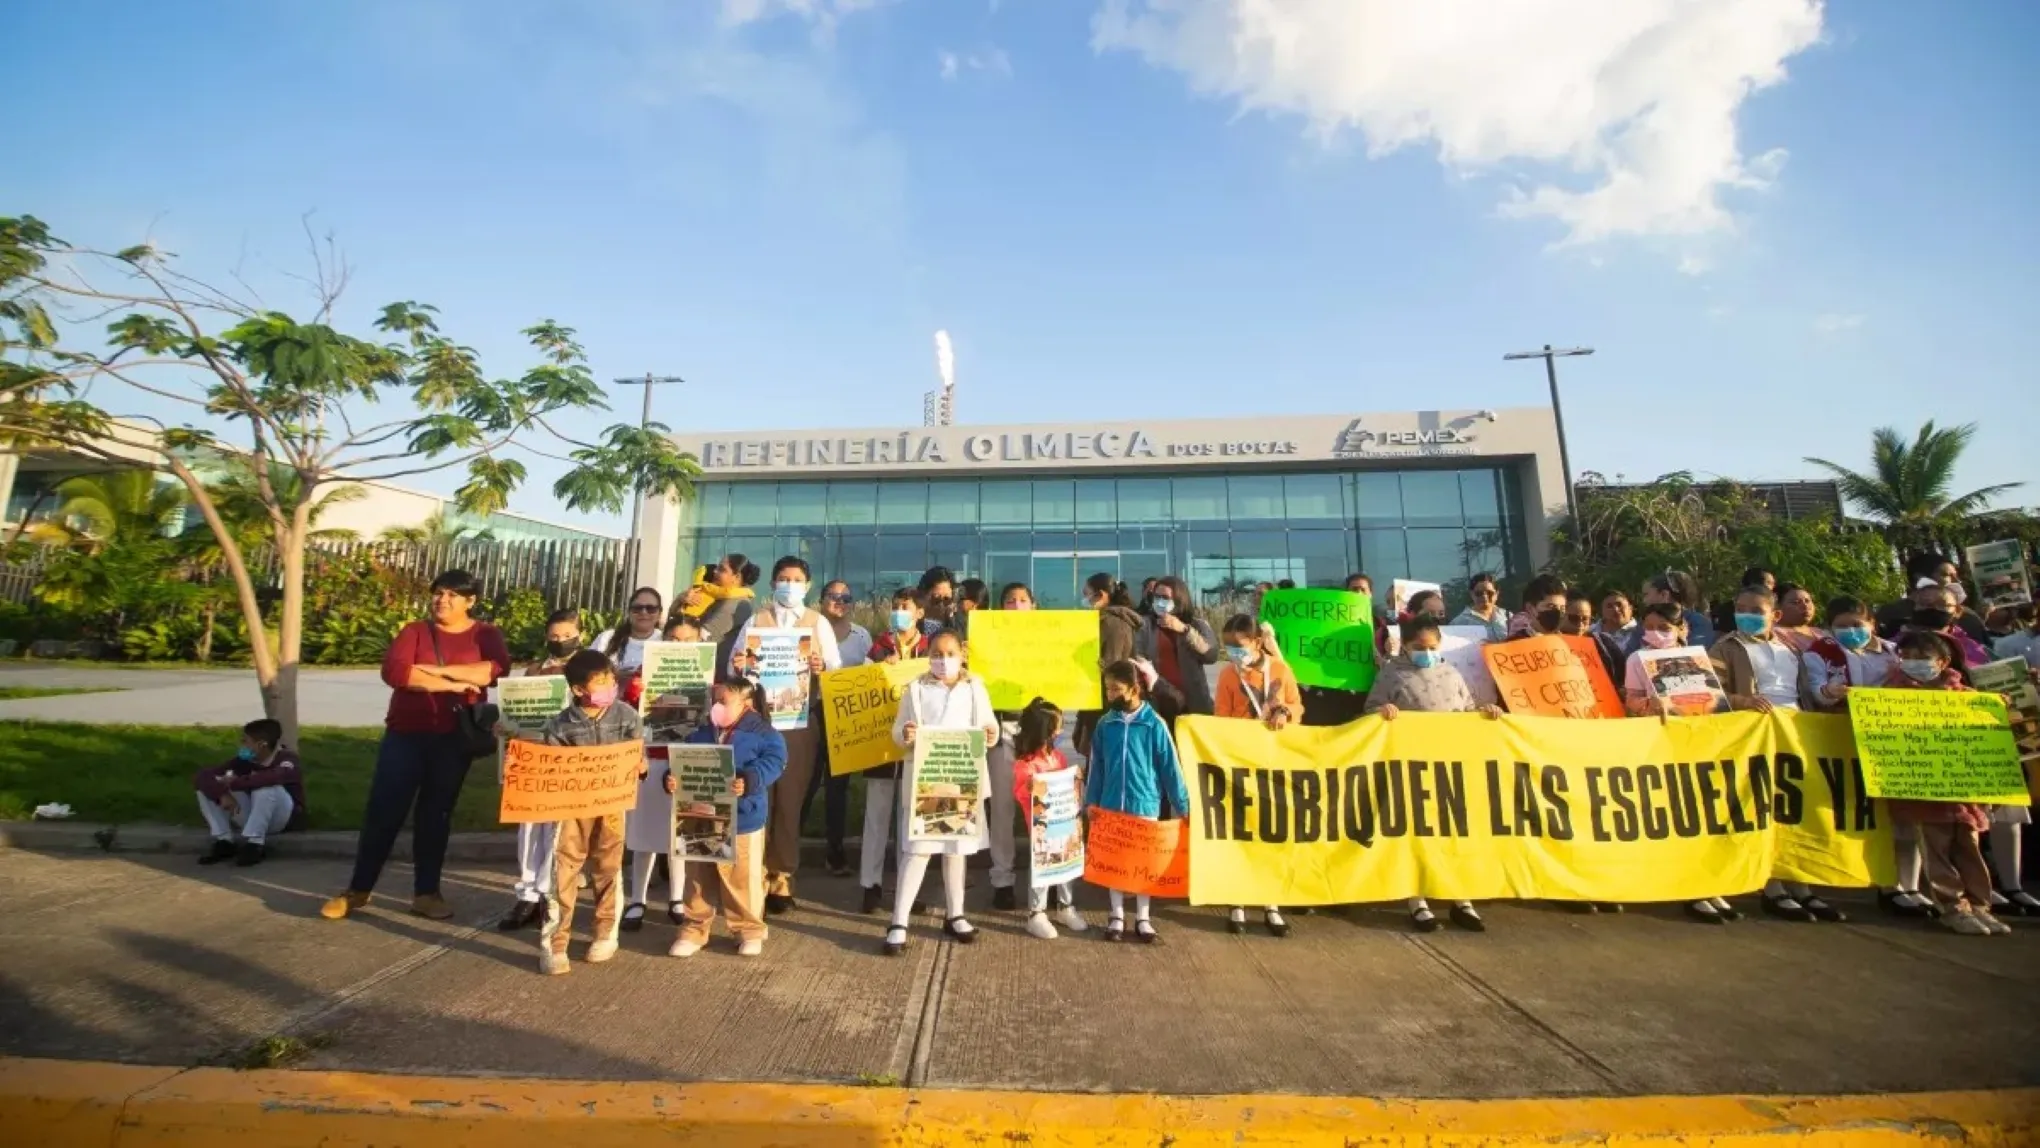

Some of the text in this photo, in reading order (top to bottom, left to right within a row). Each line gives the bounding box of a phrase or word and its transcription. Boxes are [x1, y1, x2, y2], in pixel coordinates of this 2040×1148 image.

[1384, 427, 1467, 446] PEMEX
[706, 428, 1299, 468] REFINERÍA OLMECA DOS BOCAS
[1264, 597, 1289, 620] NO
[509, 763, 619, 775] escuela mejor
[539, 753, 563, 766] me
[566, 750, 621, 765] cierren
[506, 766, 637, 793] REUBIQUENLA
[1198, 760, 1469, 849] REUBIQUEN
[1485, 760, 1573, 841] LAS
[1584, 752, 1804, 842] ESCUELAS
[1133, 865, 1184, 886] Melgar
